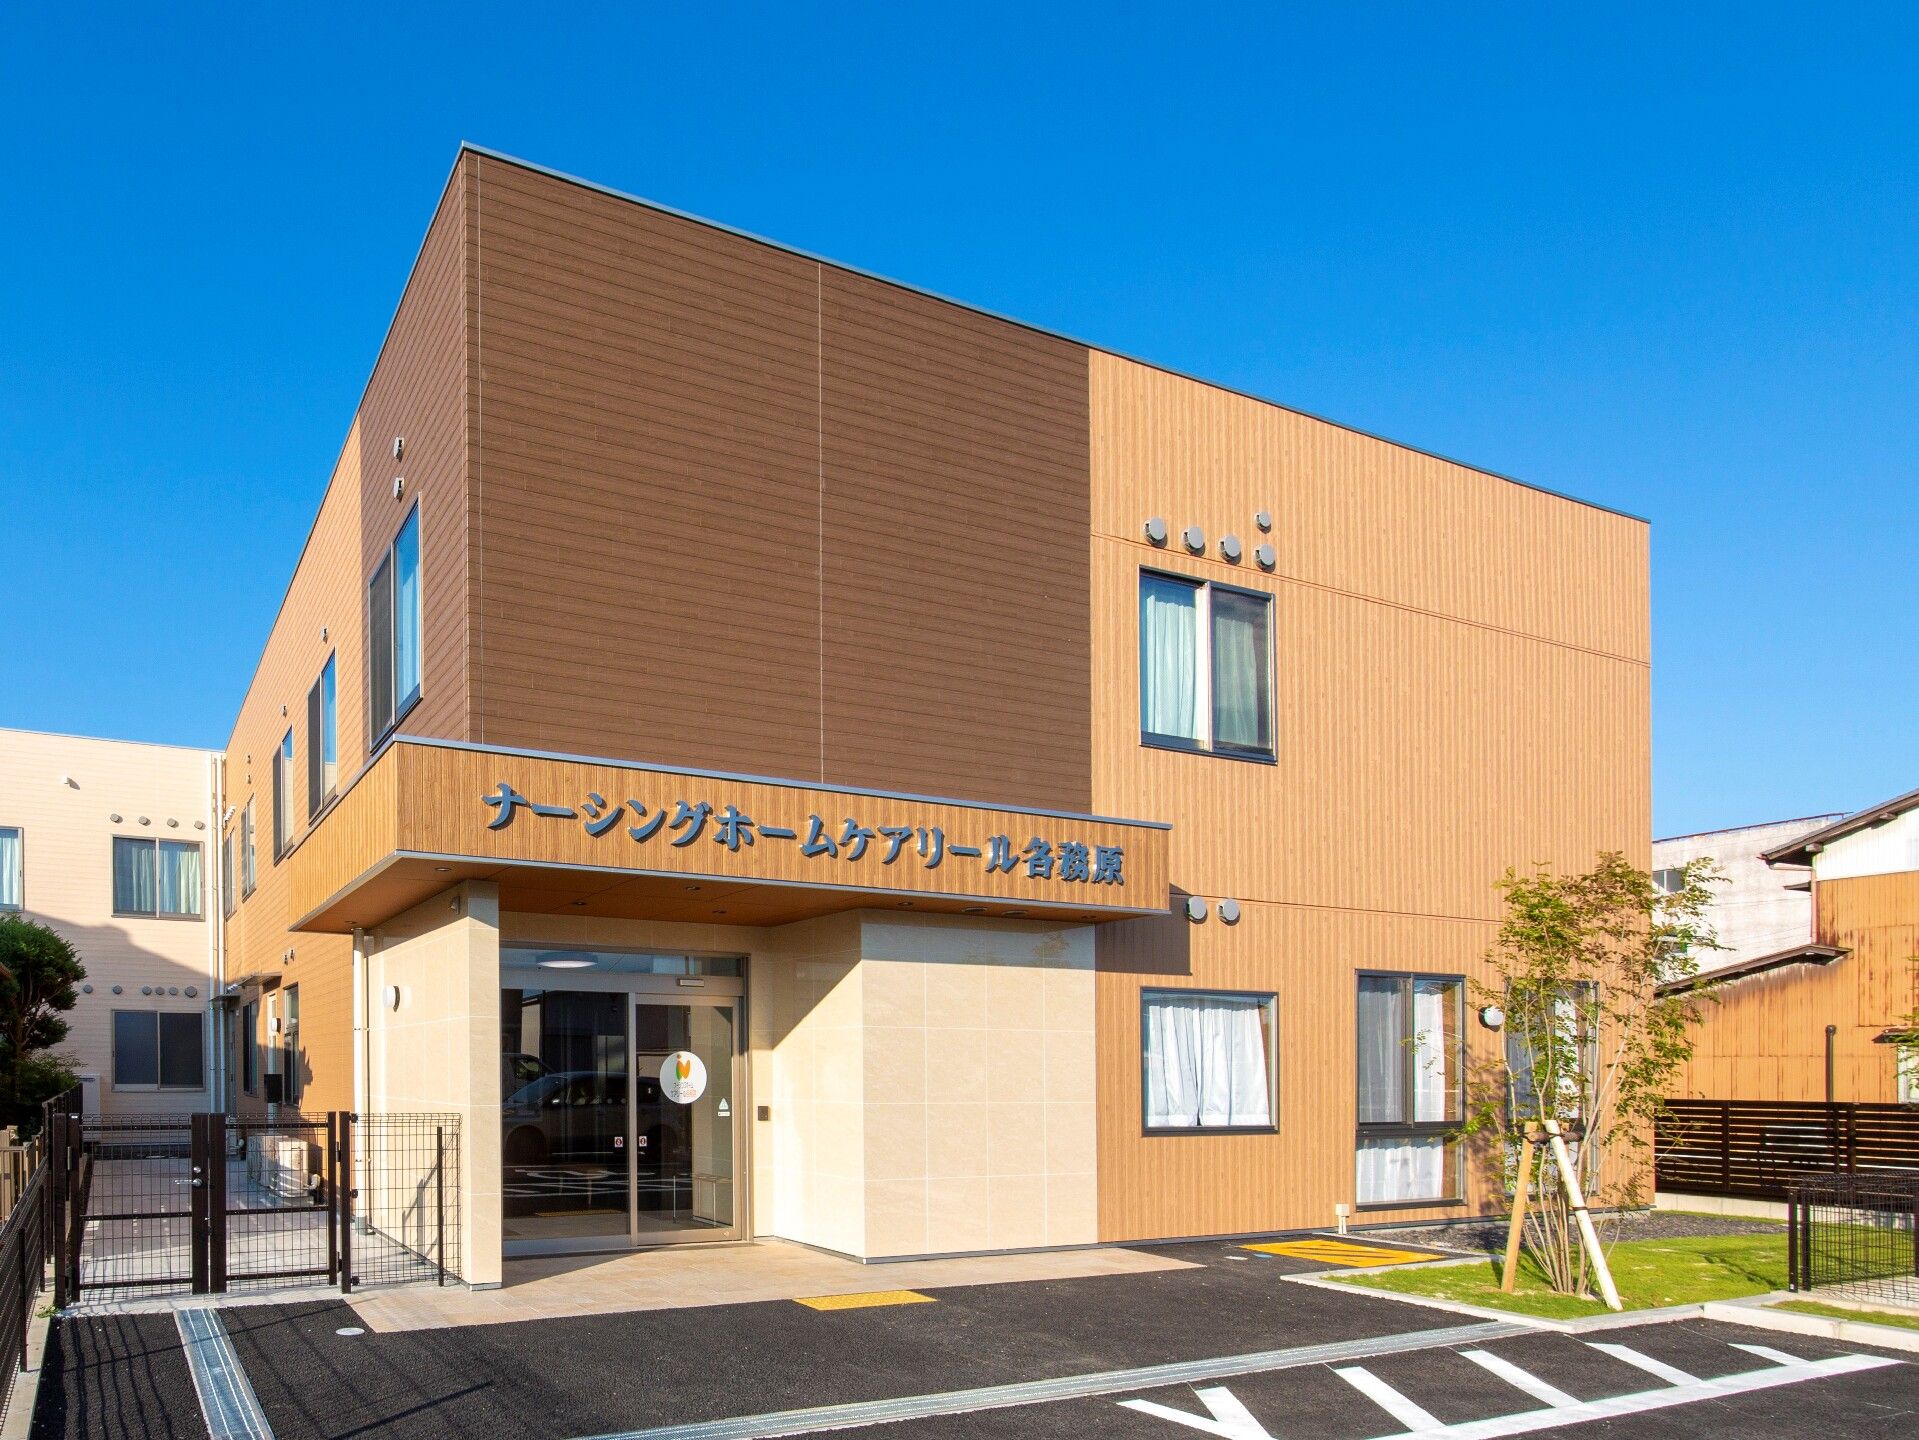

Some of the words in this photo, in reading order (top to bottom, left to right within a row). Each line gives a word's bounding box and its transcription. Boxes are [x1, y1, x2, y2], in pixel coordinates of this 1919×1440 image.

[482, 783, 1124, 884] ナーシングホームケアリール各務原
